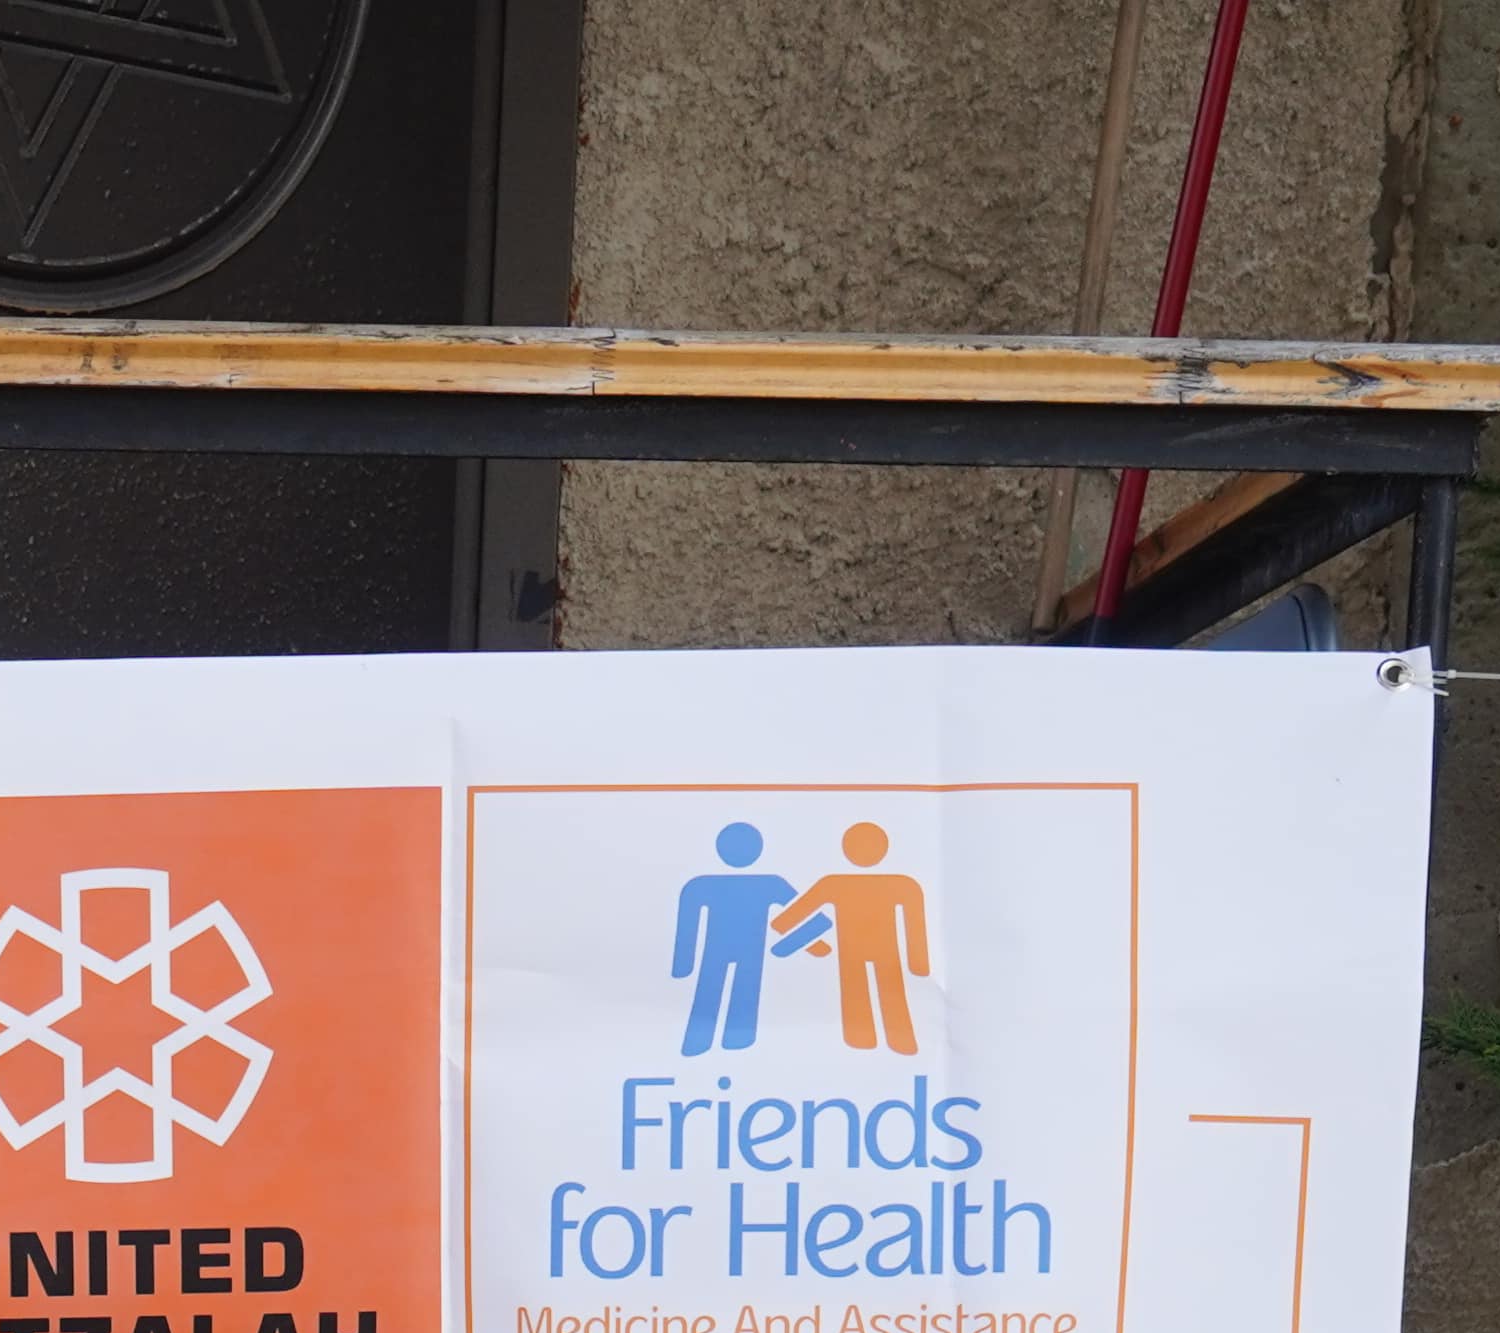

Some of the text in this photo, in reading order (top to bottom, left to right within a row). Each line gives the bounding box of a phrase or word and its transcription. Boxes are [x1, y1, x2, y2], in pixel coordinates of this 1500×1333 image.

[622, 1076, 984, 1172] Friends
[550, 1180, 1052, 1281] for Health
